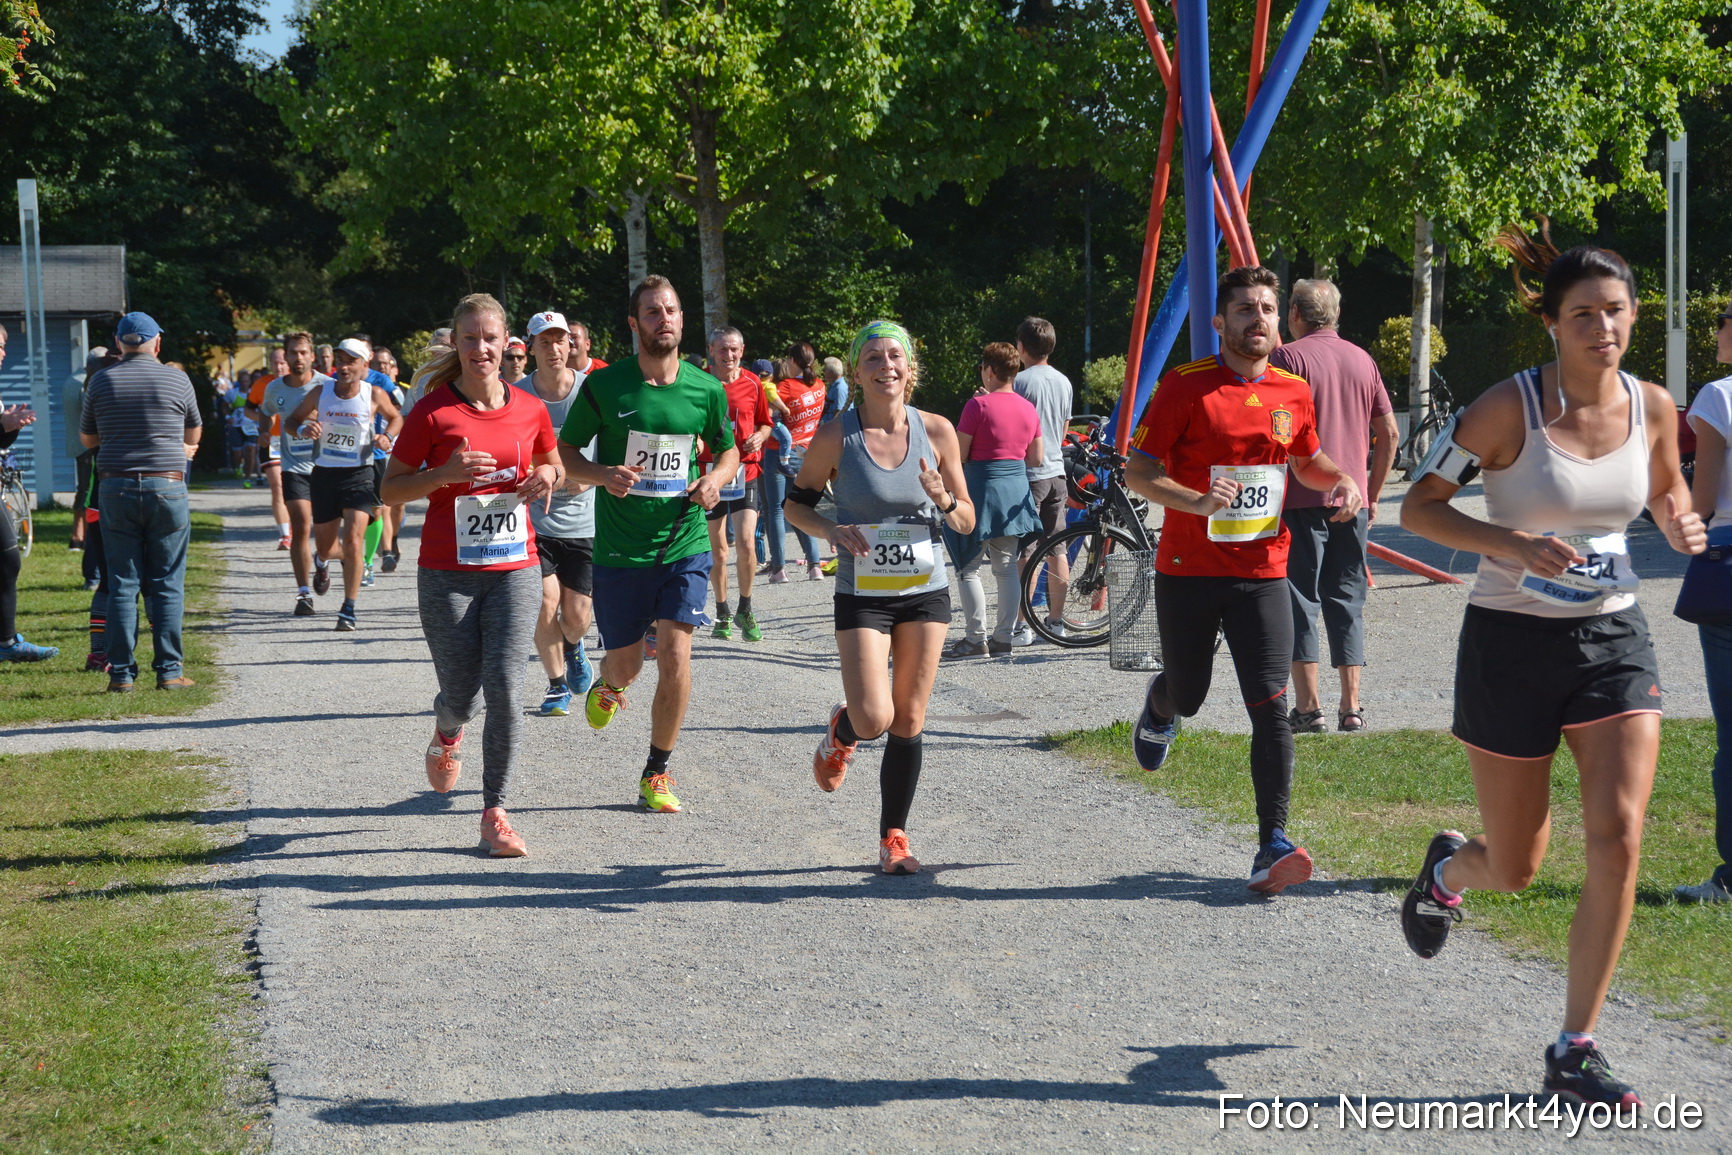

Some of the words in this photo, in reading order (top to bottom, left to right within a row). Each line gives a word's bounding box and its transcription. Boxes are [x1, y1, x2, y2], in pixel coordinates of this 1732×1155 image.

[327, 432, 355, 447] 2276
[648, 440, 675, 448] BOCK
[636, 450, 681, 471] 2105
[1235, 471, 1267, 481] BOCK
[645, 481, 667, 490] Manu
[467, 512, 517, 535] 2470
[878, 530, 910, 538] BOCK
[480, 545, 510, 557] Marina
[874, 544, 916, 566] 334
